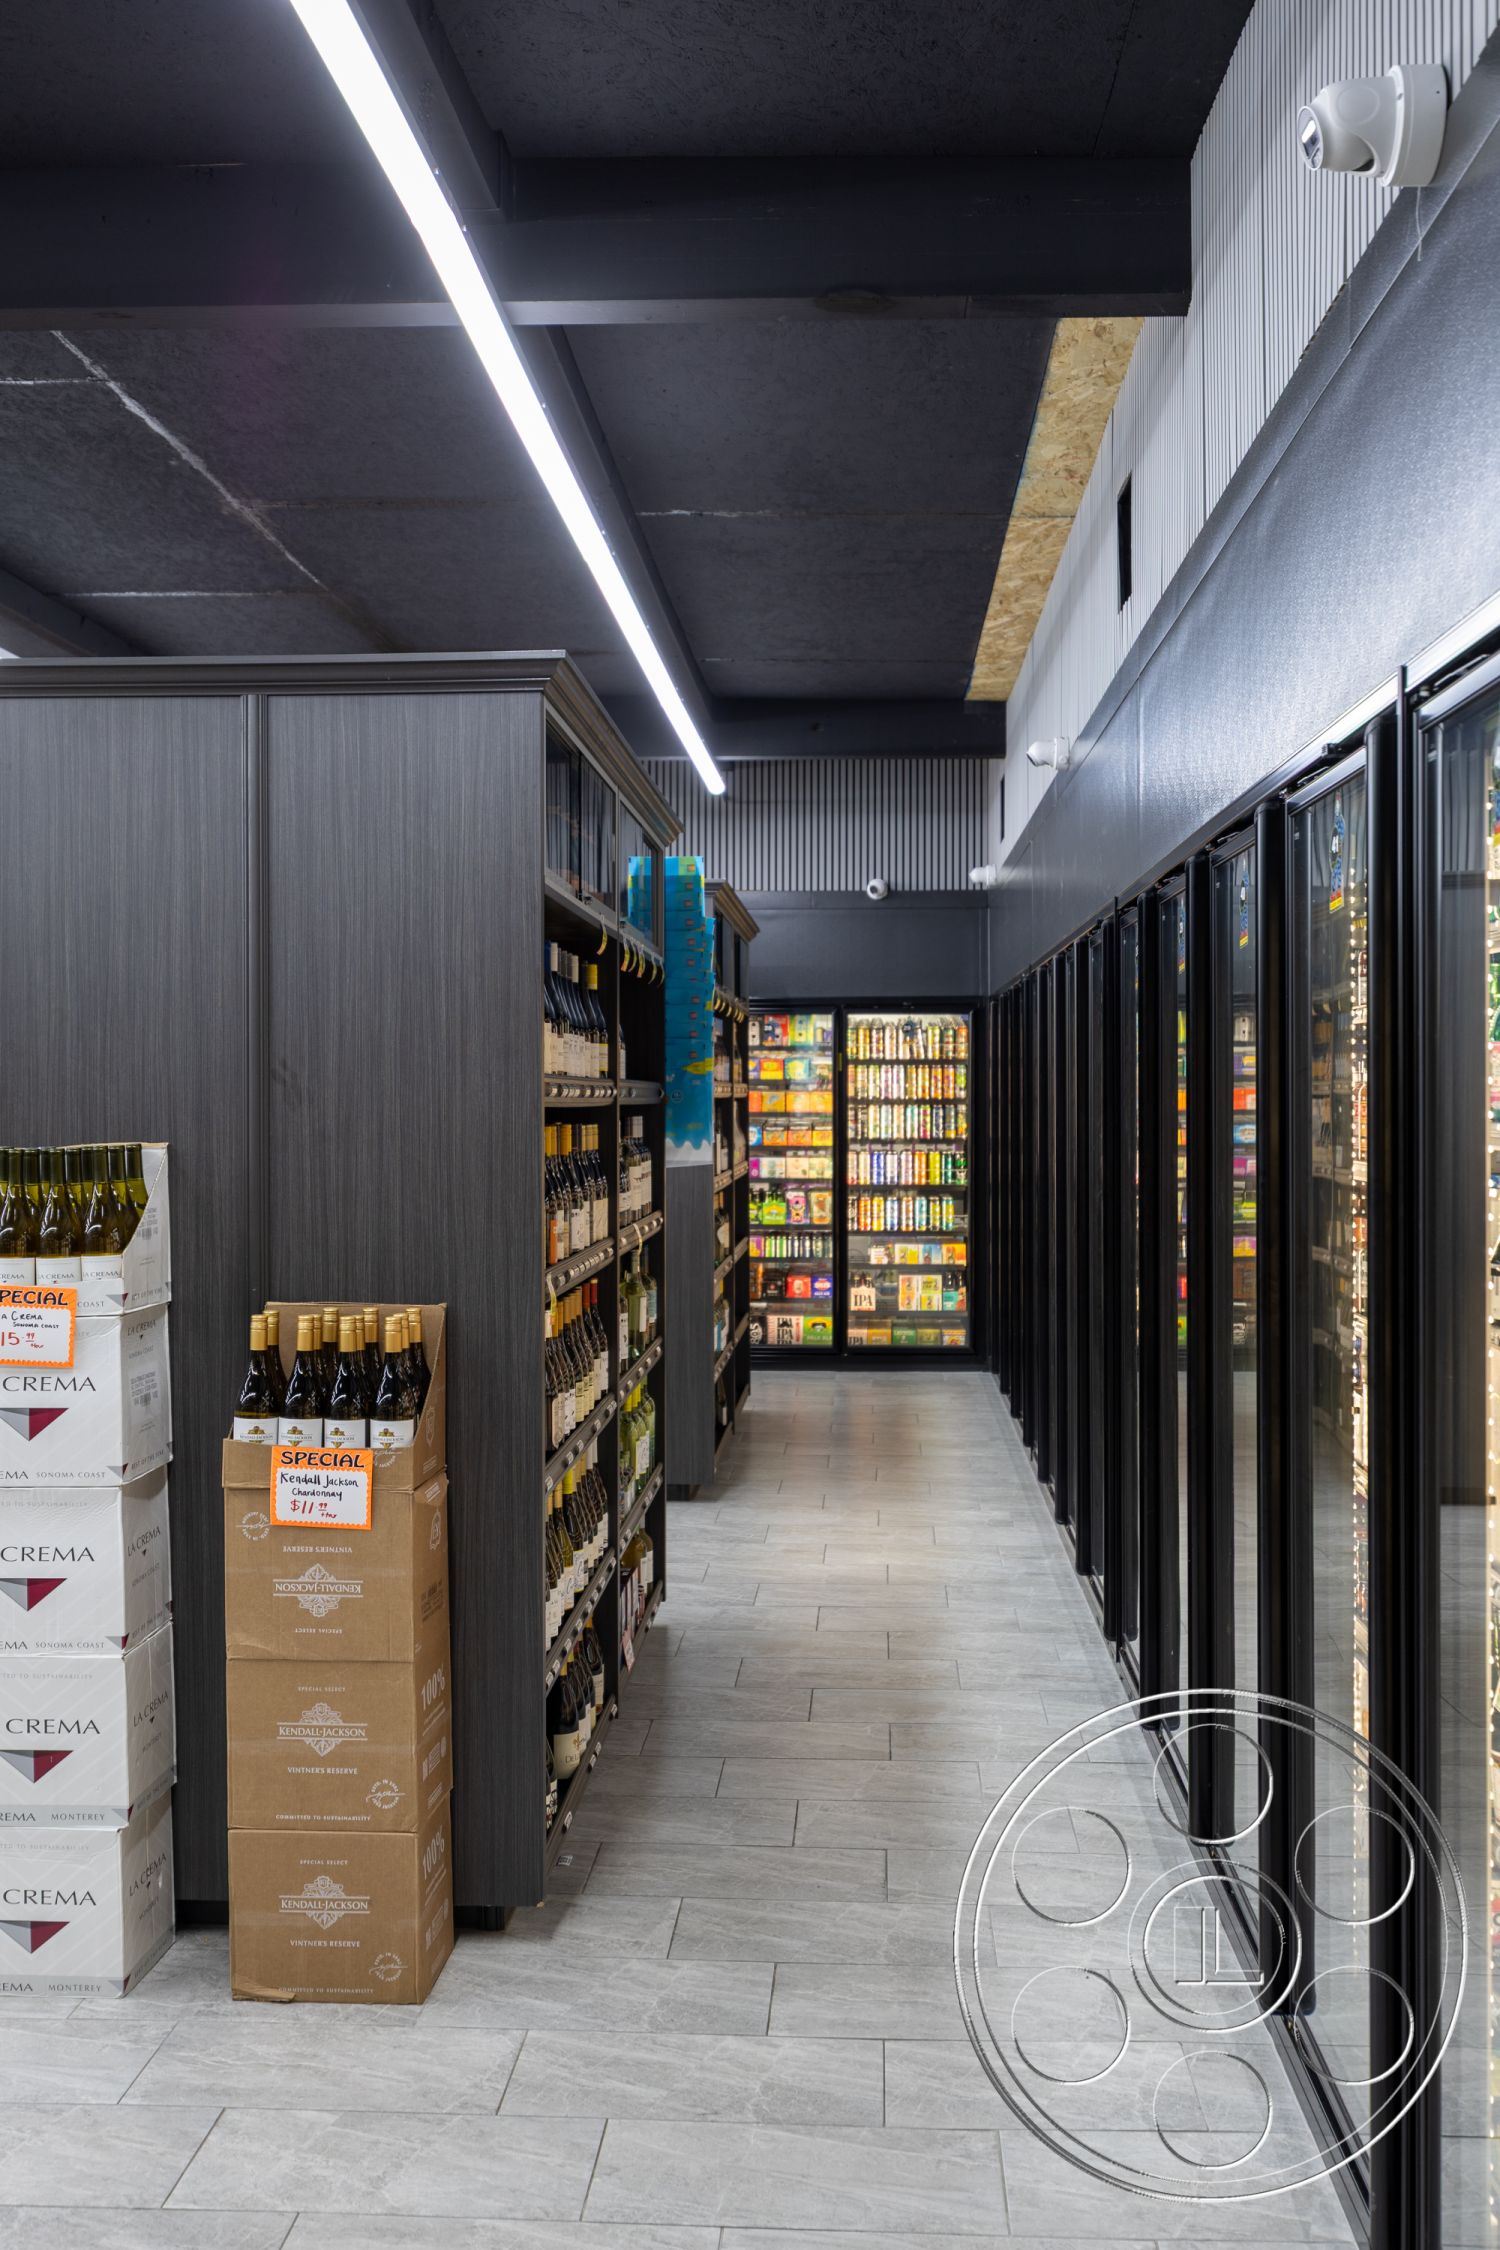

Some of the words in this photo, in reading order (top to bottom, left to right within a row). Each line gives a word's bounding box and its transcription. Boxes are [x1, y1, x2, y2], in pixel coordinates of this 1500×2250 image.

[854, 1294, 873, 1307] IPA
[2, 1376, 96, 1392] CREMA
[280, 1451, 365, 1468] SPECIAL
[280, 1472, 321, 1485] Kendall
[324, 1474, 359, 1488] Jackson
[291, 1487, 343, 1501] Chardonnay
[136, 1526, 161, 1549] CREMA
[0, 1546, 95, 1562] CREMA
[282, 1545, 313, 1553] RESERVE
[275, 1583, 361, 1595] KENDALL-JACKSON
[35, 1641, 74, 1649] SONOMA
[77, 1641, 104, 1649] COAST
[133, 1714, 143, 1727] LA
[143, 1690, 169, 1717] CREMA
[5, 1718, 101, 1735] CREMA
[278, 1726, 366, 1738] KENDALL-JACKSON
[326, 1767, 358, 1775] RESERVE
[51, 1813, 105, 1821] MONTEREY
[129, 1880, 139, 1897] LA
[140, 1852, 167, 1884] CREMA
[3, 1889, 97, 1906] CREMA
[281, 1899, 369, 1910] KENDALL-JACKSON
[329, 1940, 361, 1948] RESERVE
[0, 1983, 33, 1992] EMA
[48, 1983, 102, 1992] MONTEREY
